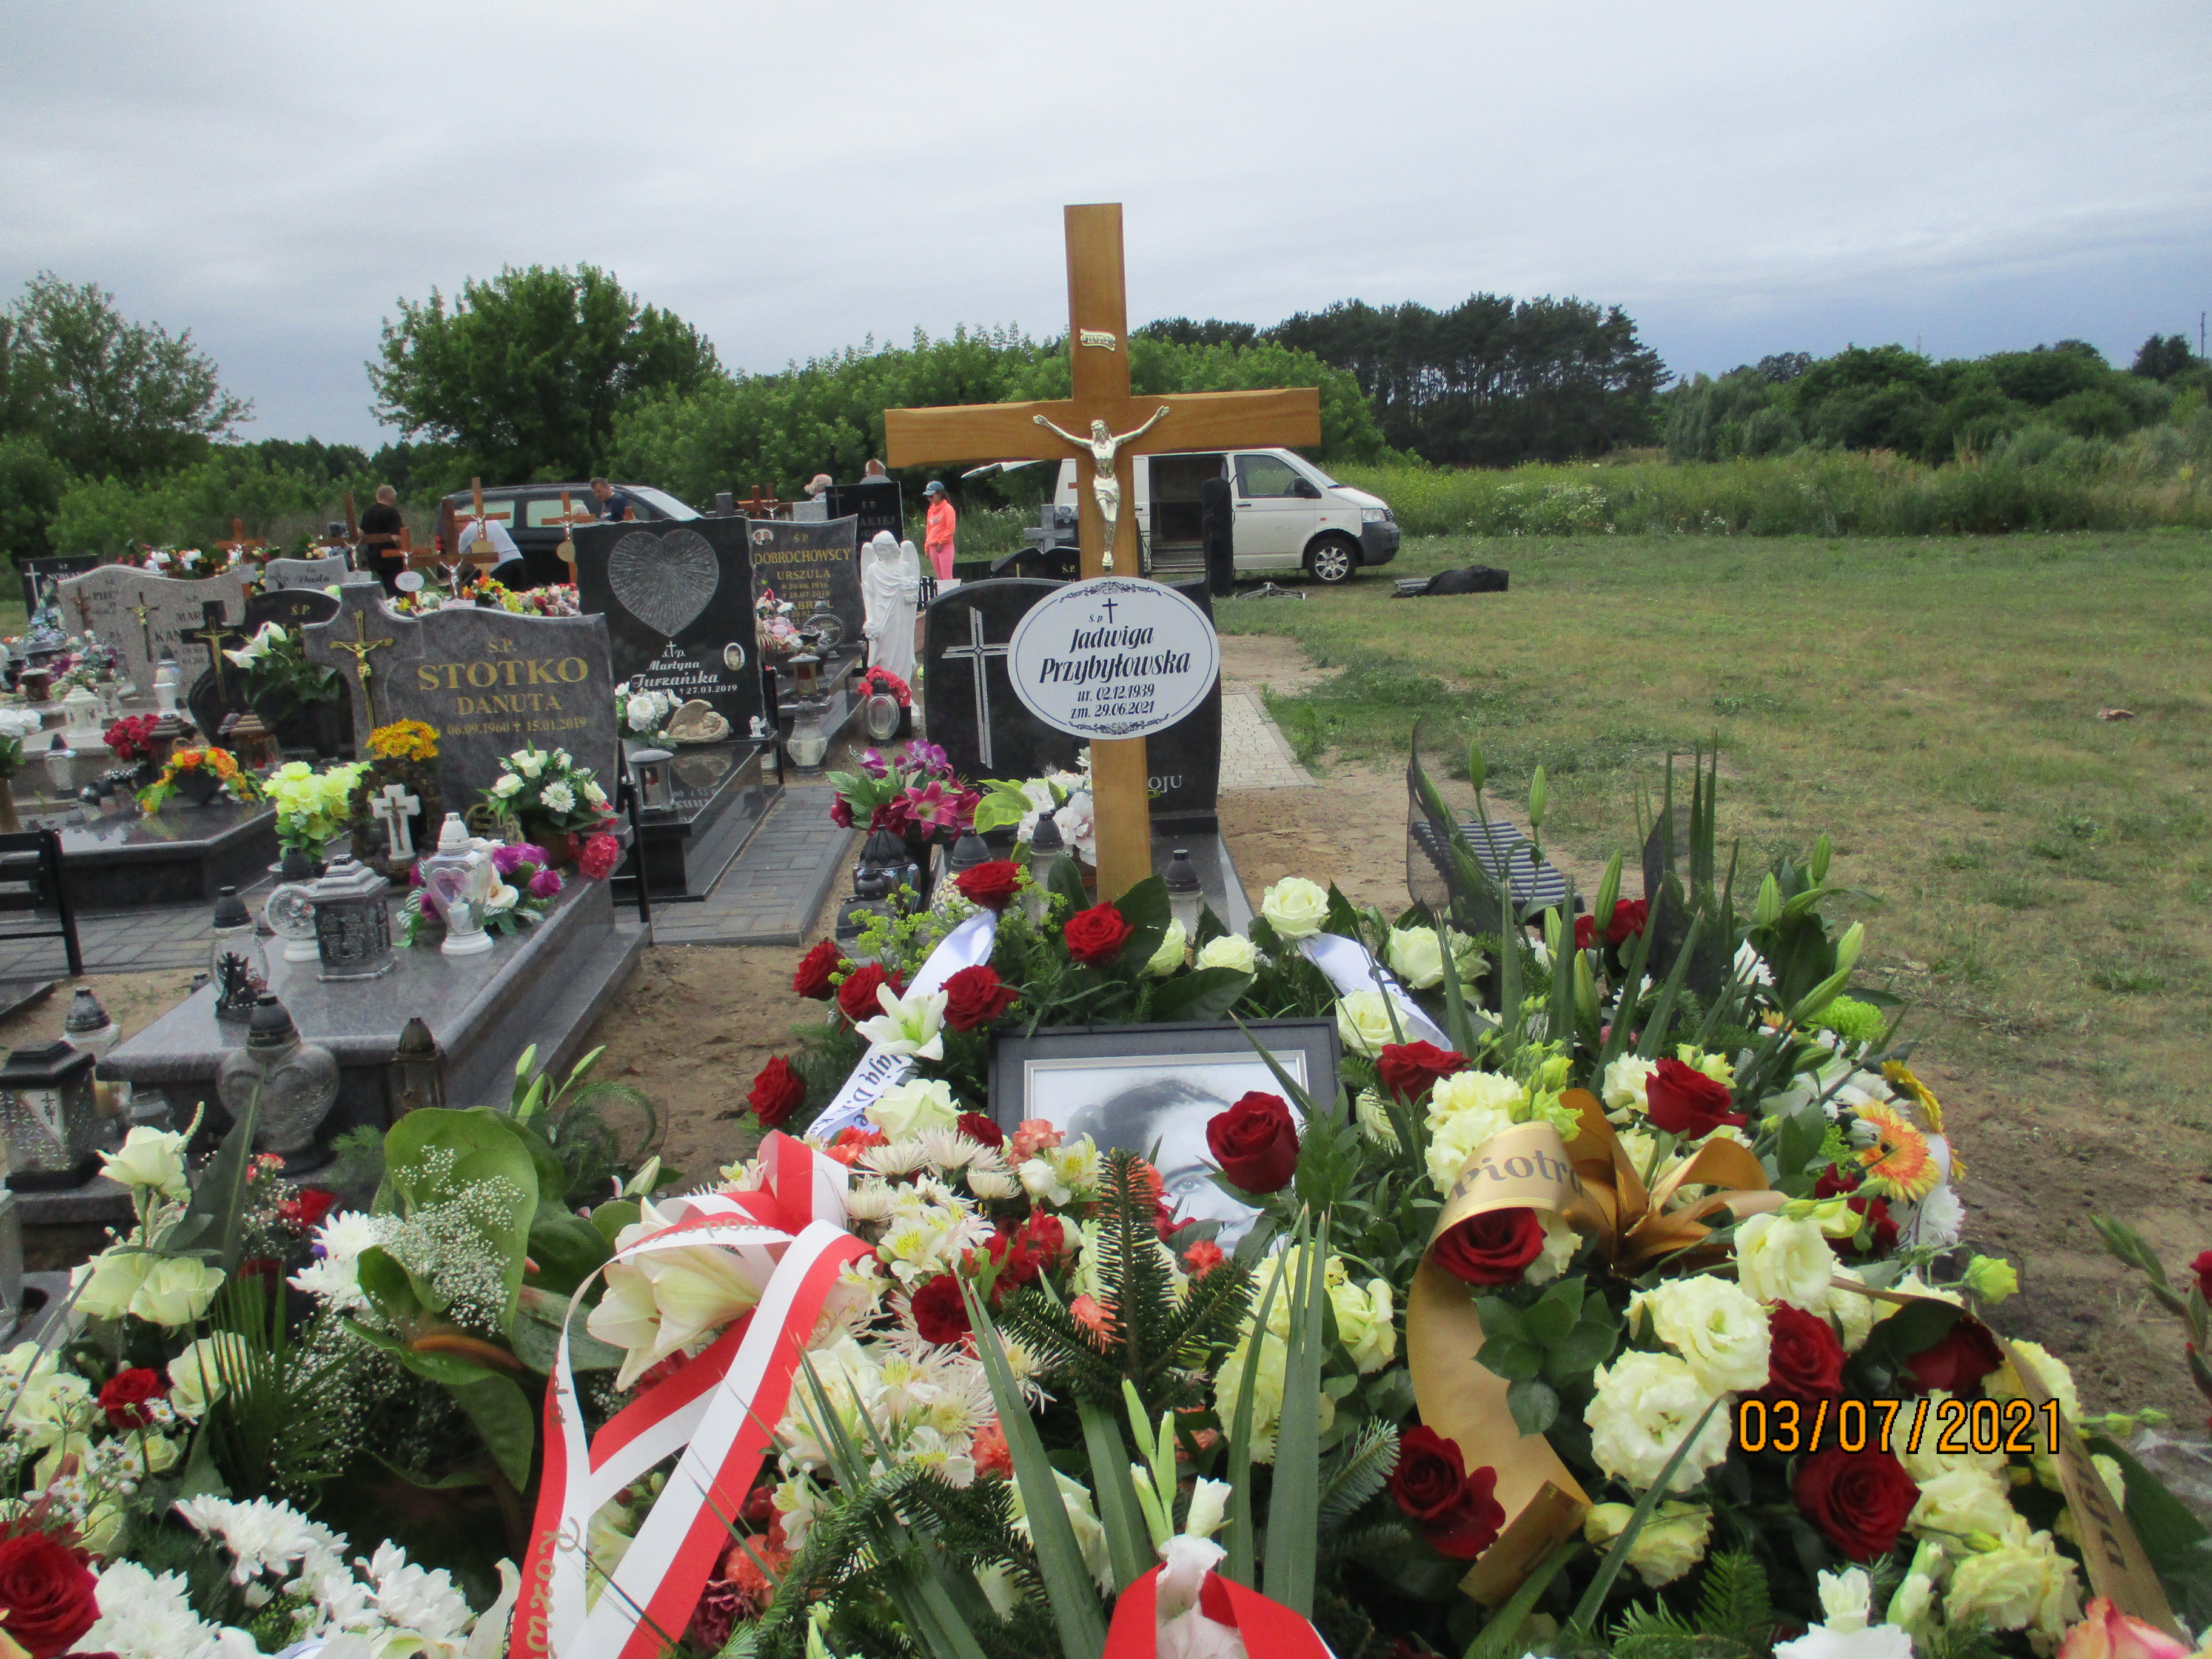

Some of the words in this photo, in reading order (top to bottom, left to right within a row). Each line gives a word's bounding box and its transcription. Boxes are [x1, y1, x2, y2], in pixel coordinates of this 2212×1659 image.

[754, 548, 851, 564] DOBROCHOWSCY
[777, 569, 831, 580] URSZULA
[1069, 625, 1154, 654] Jadwiga
[417, 657, 589, 691] STOTKO
[646, 660, 701, 671] Martyna
[1039, 649, 1191, 685] Przybyłowska
[631, 670, 719, 688] Turzańska
[686, 685, 738, 695] 27.03.2019
[1078, 689, 1093, 702] ur.
[1096, 683, 1155, 701] 02.12.1939
[456, 693, 563, 716] DANUTA
[1071, 707, 1091, 719] zm.
[1094, 700, 1155, 718] 29.06.2021
